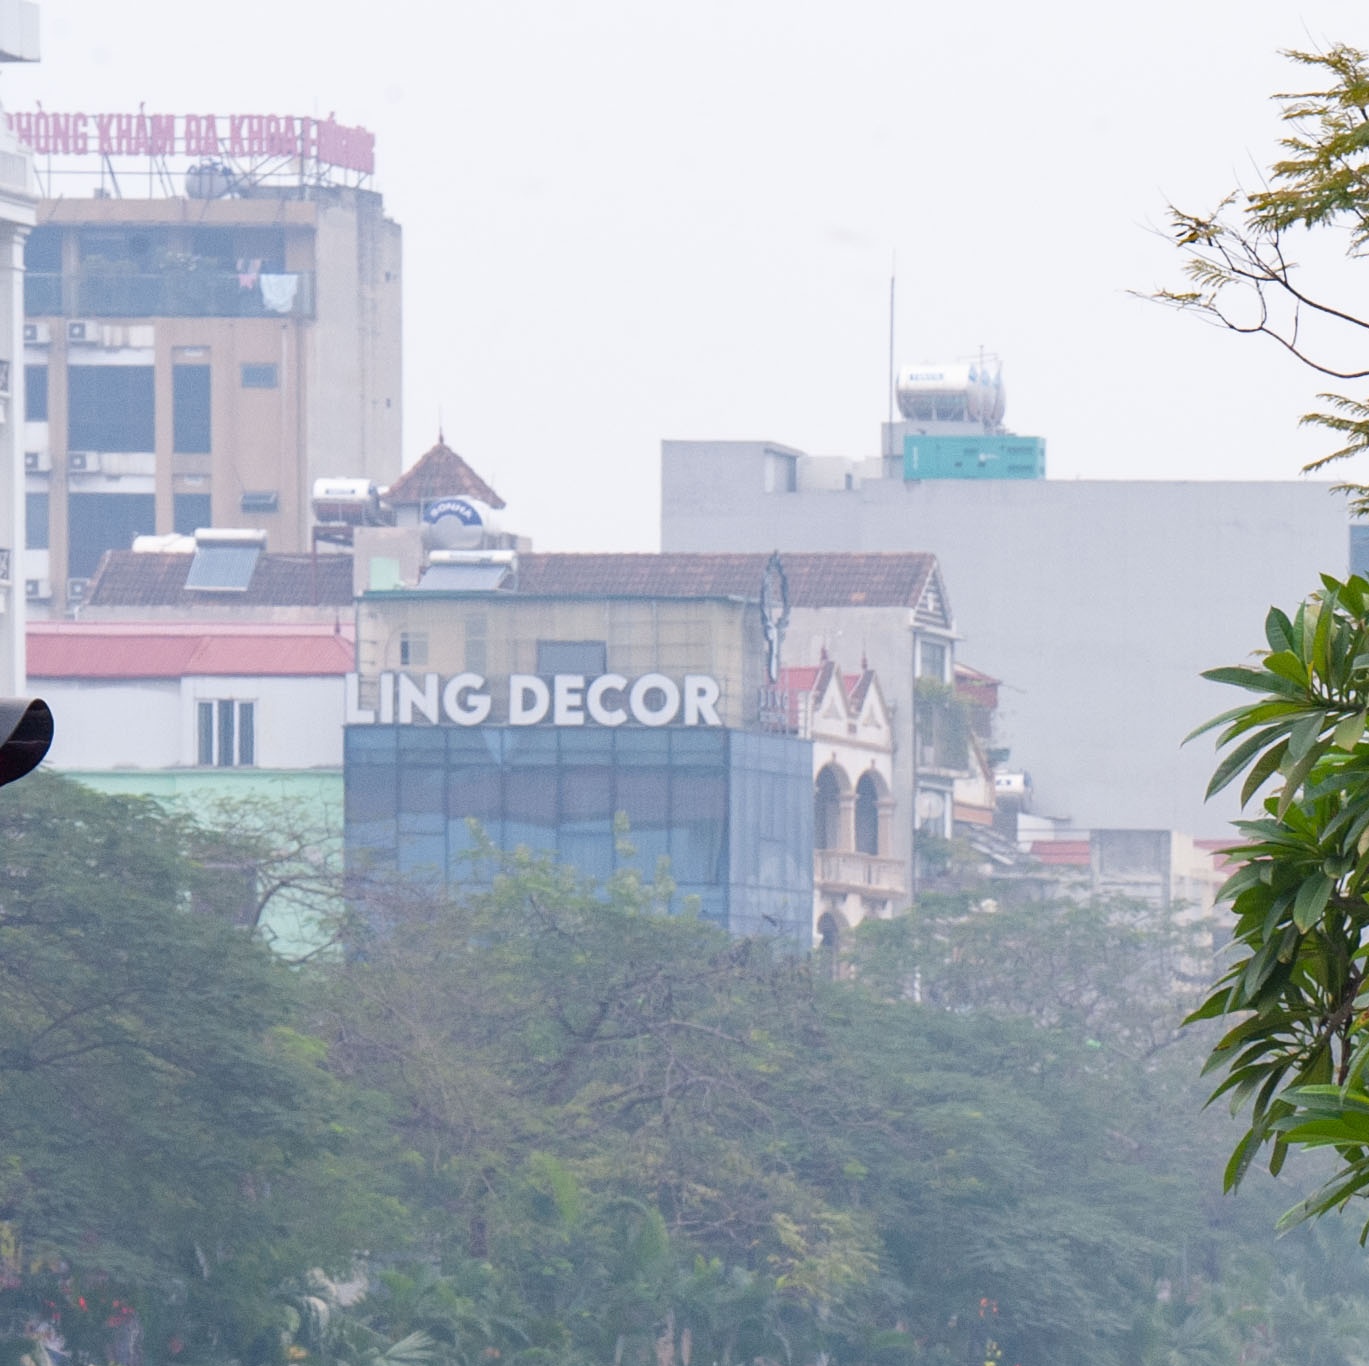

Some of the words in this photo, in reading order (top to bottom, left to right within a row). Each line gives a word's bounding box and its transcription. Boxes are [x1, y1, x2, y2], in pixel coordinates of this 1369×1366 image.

[229, 113, 298, 157] KHOA
[345, 672, 492, 726] LING
[508, 672, 722, 726] DECOR
